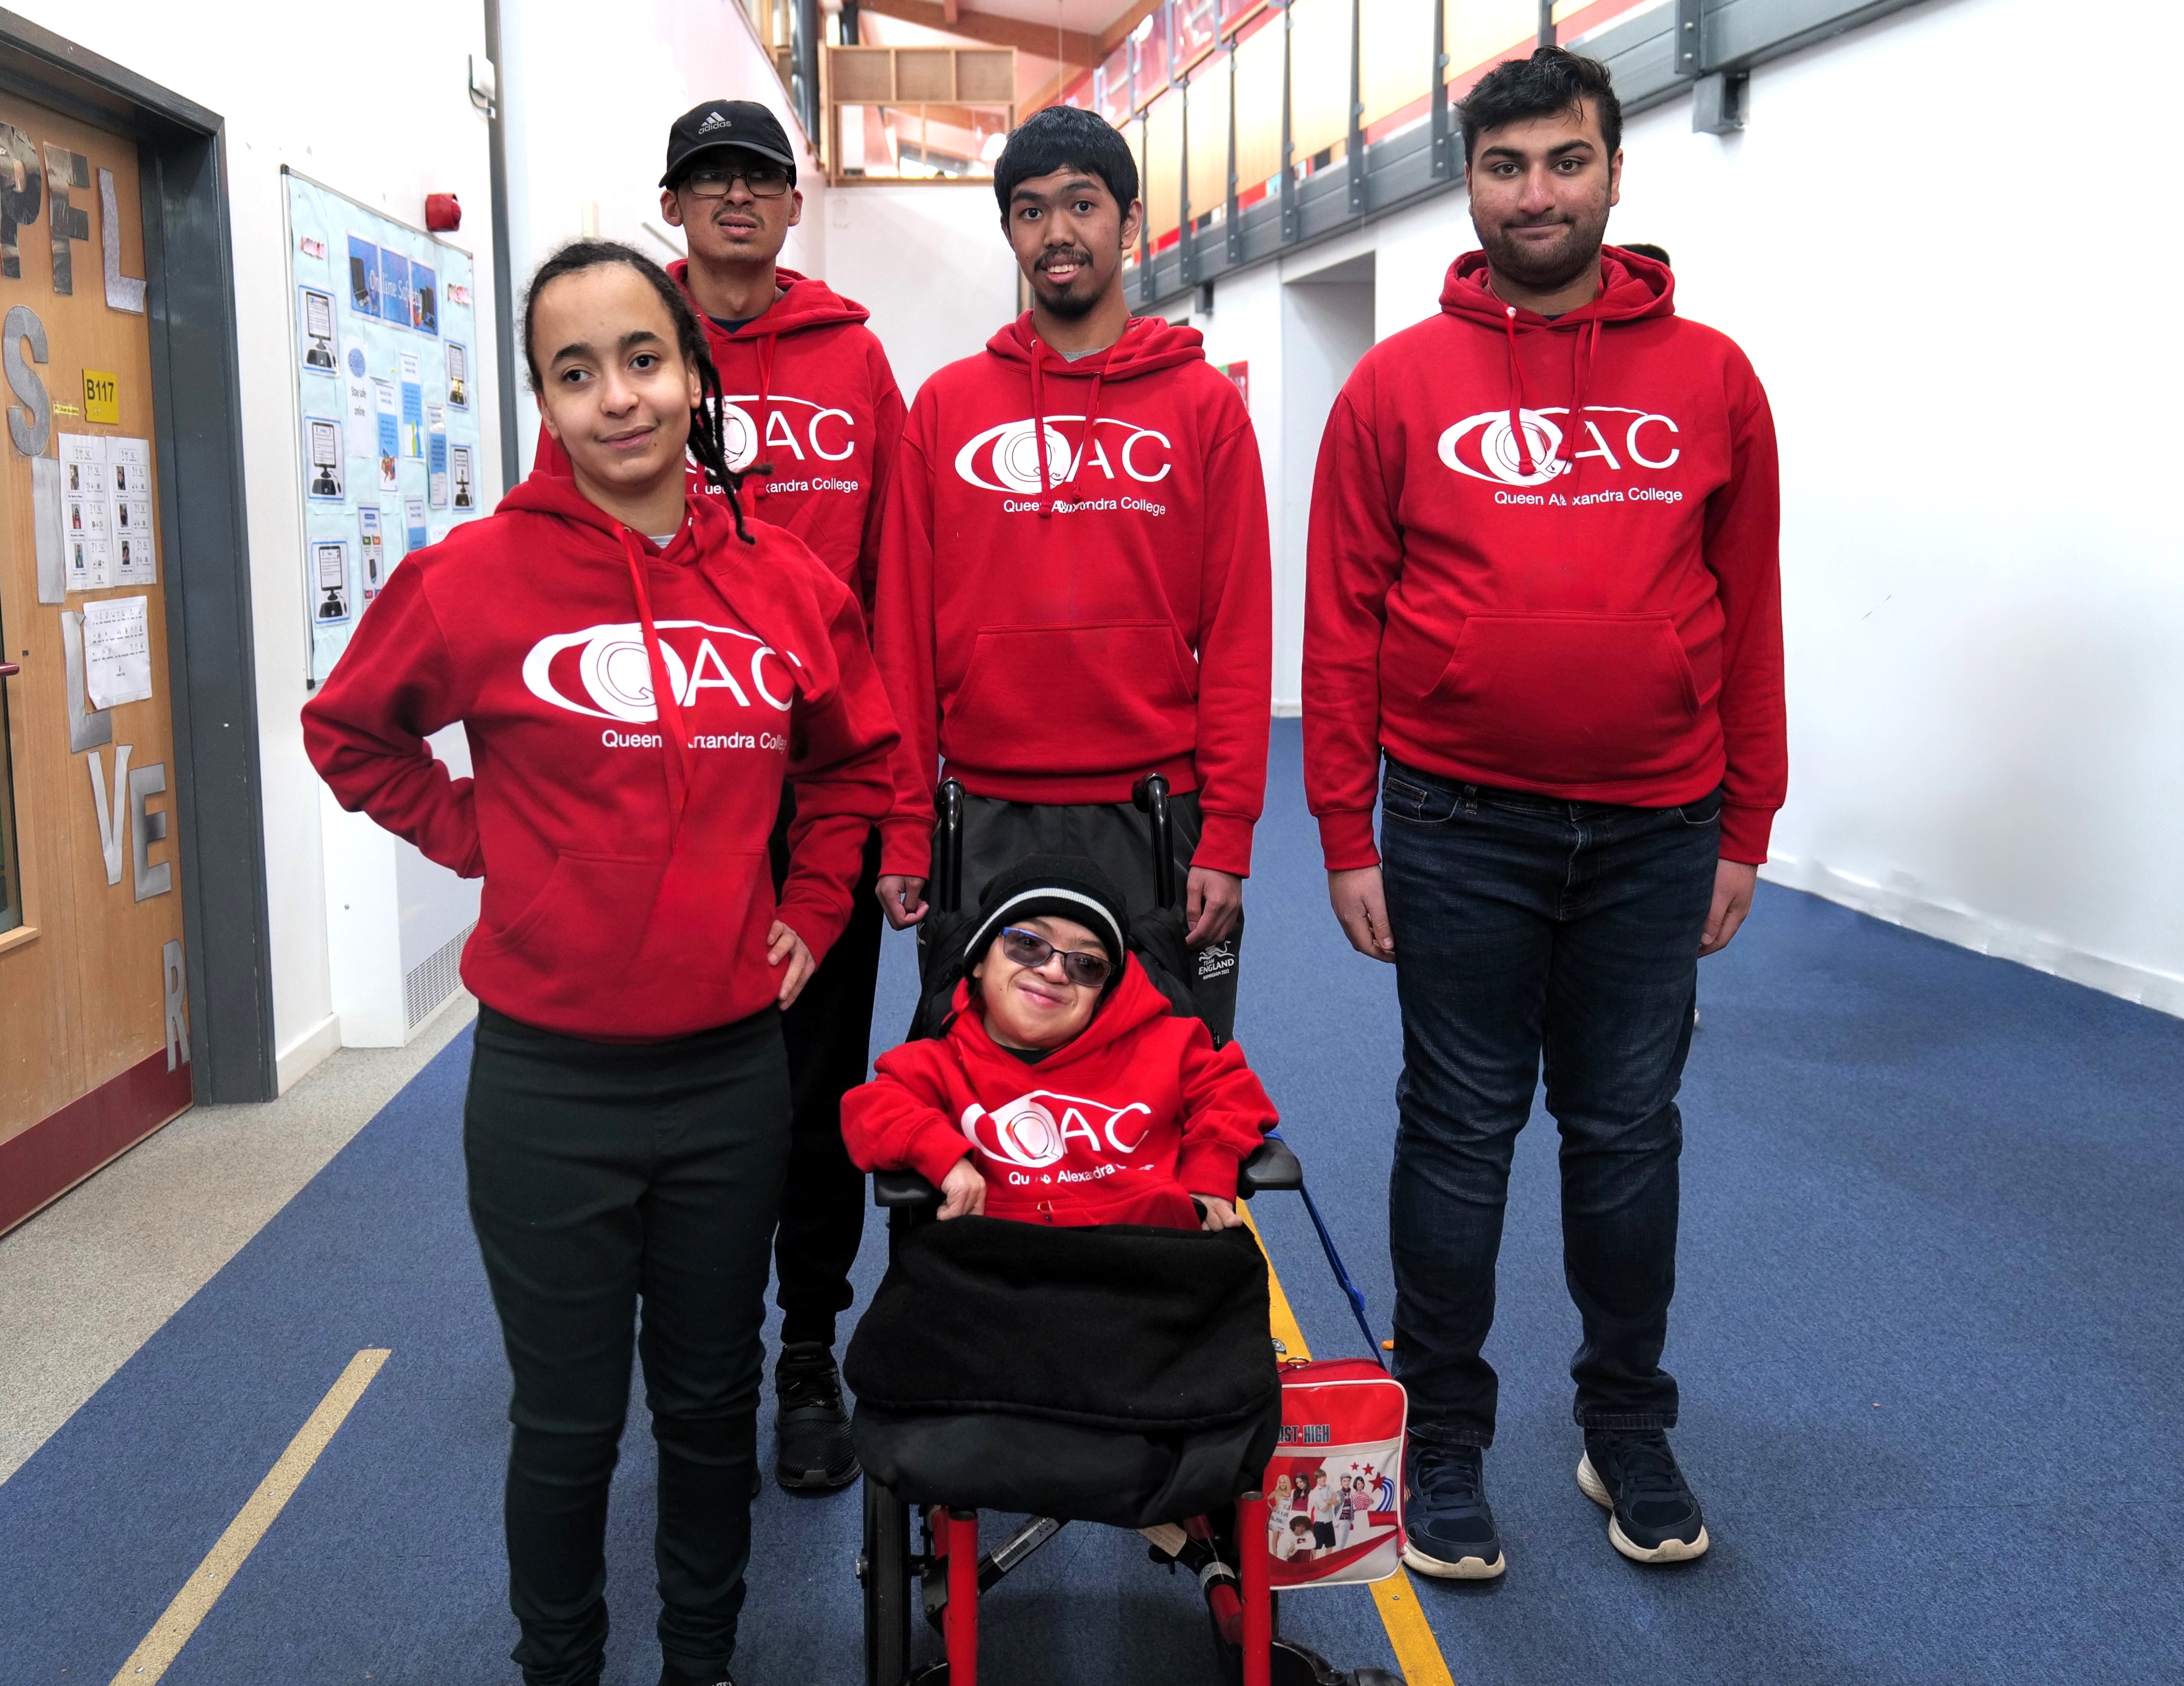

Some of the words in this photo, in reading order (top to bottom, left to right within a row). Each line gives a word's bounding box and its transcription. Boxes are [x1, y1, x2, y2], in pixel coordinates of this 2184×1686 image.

[698, 120, 731, 134] adidas
[86, 378, 114, 403] B117
[1488, 413, 1680, 479] QAC
[998, 427, 1171, 486] QAC
[766, 479, 808, 494] andra
[812, 477, 858, 493] College
[1494, 491, 1544, 506] Queen
[1548, 489, 1624, 506] Alxandra
[1628, 487, 1683, 504] College
[1120, 496, 1166, 517] College
[585, 636, 802, 716] QAC
[602, 729, 662, 748] Queen
[1198, 958, 1235, 975] ENGLAND
[1203, 958, 1215, 966] TEAM
[1203, 970, 1221, 980] BIRMINGHAM
[999, 1102, 1151, 1162] QAC
[1277, 1425, 1299, 1444] AST
[1303, 1424, 1330, 1444] HIGH
